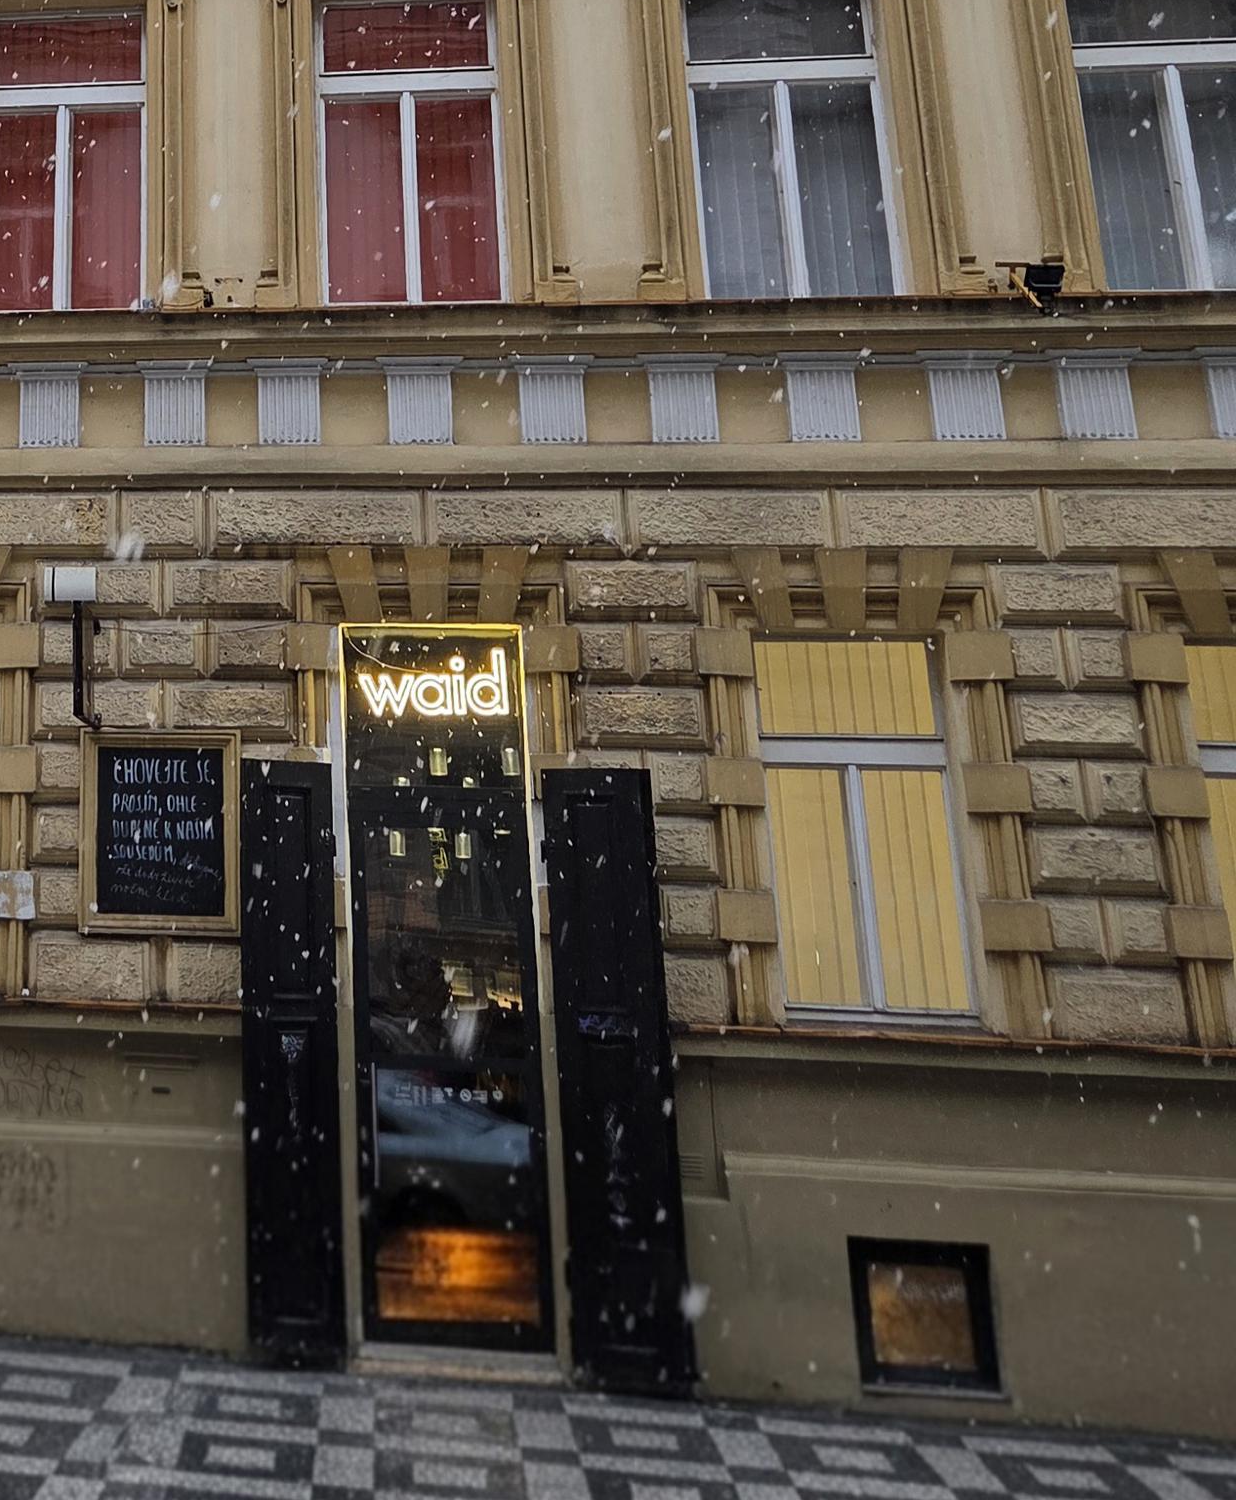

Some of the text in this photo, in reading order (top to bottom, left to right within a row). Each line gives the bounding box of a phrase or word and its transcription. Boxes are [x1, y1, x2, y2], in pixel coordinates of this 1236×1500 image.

[358, 647, 510, 717] waid
[114, 757, 189, 785] CHOVEJTE
[164, 820, 172, 840] K
